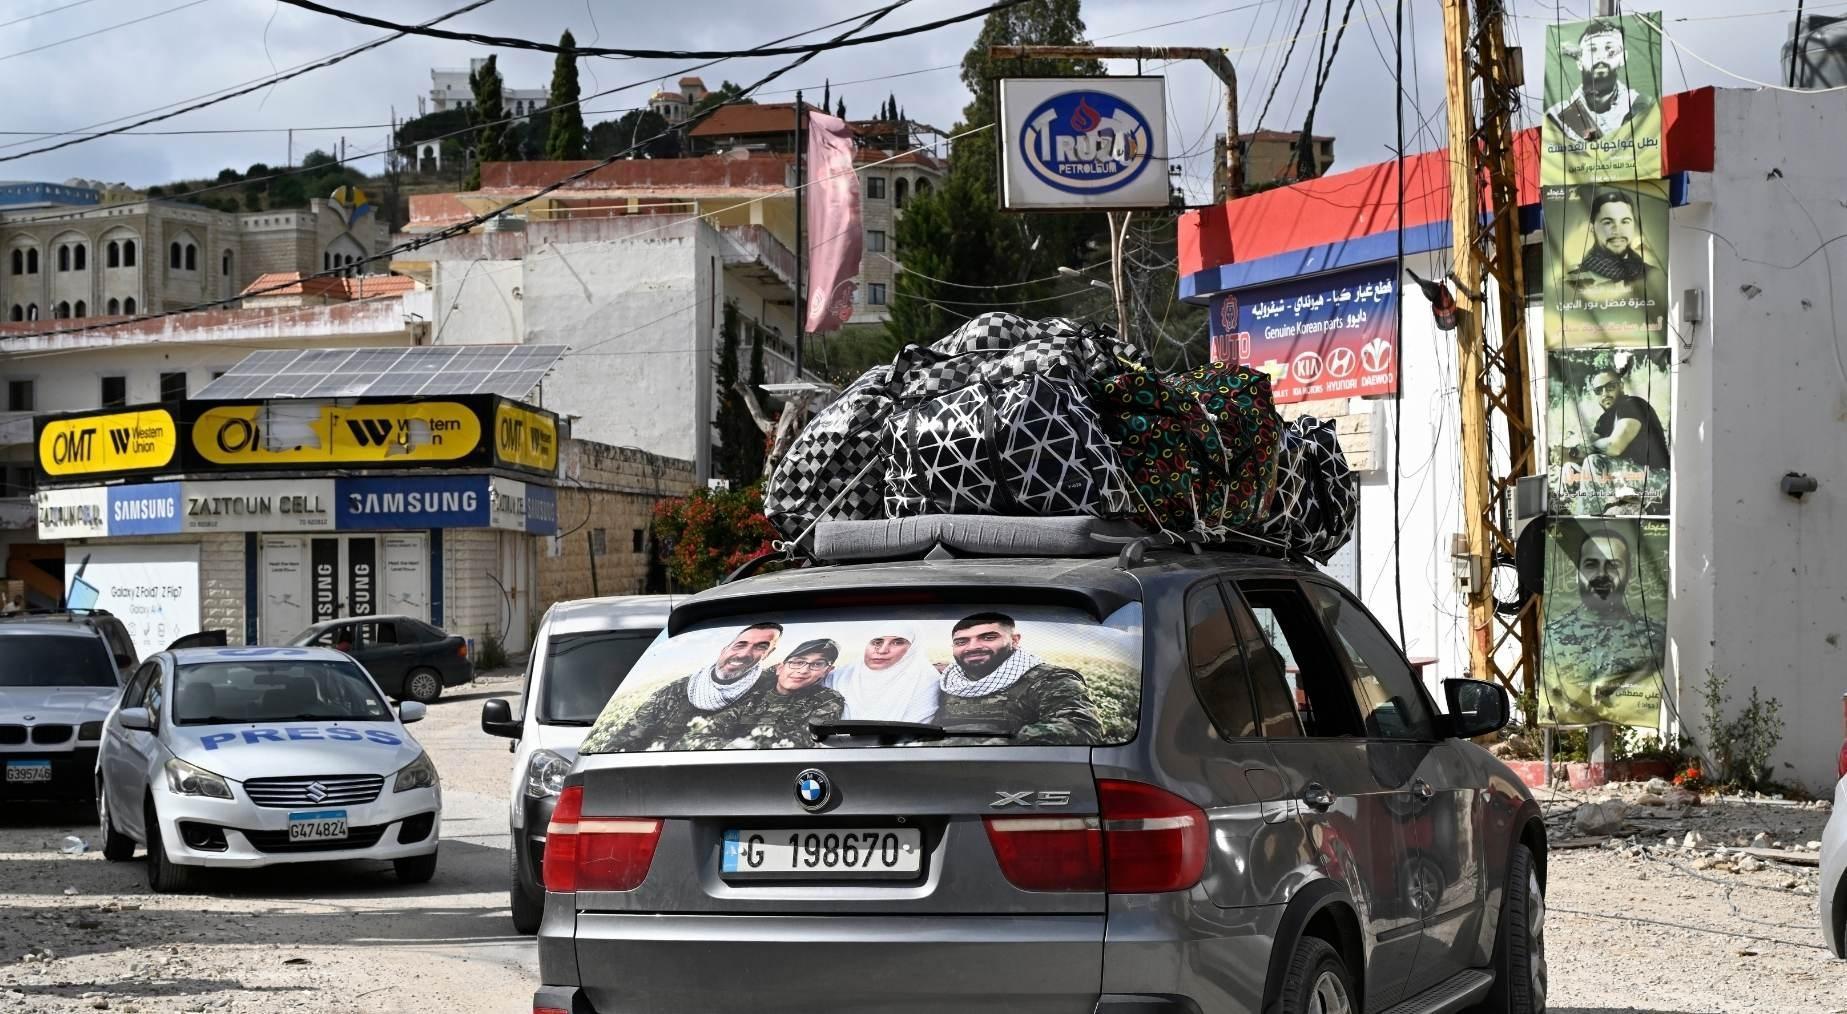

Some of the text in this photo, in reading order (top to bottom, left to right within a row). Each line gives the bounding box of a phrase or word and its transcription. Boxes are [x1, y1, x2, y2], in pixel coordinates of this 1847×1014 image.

[1637, 137, 1658, 150] بطل
[1332, 288, 1351, 306] كيا
[1354, 283, 1374, 302] غيار
[1374, 278, 1393, 301] قطع
[1265, 318, 1343, 340] Genuine Korean parts
[1210, 331, 1251, 363] AUTO
[1297, 359, 1319, 375] KIA
[132, 426, 163, 439] Western
[397, 418, 461, 432] Wtern
[53, 428, 97, 465] OMT
[132, 442, 155, 454] Union
[114, 497, 175, 522] SAMSUNG
[188, 495, 326, 516] ZAITOUN CELL
[349, 491, 477, 514] SAMSUNG
[111, 586, 135, 600] Galaxy
[200, 727, 402, 750] PRESS
[8, 768, 50, 780] G395746
[989, 791, 1071, 806] X5
[290, 821, 346, 838] G474824
[747, 832, 899, 868] G 198670
